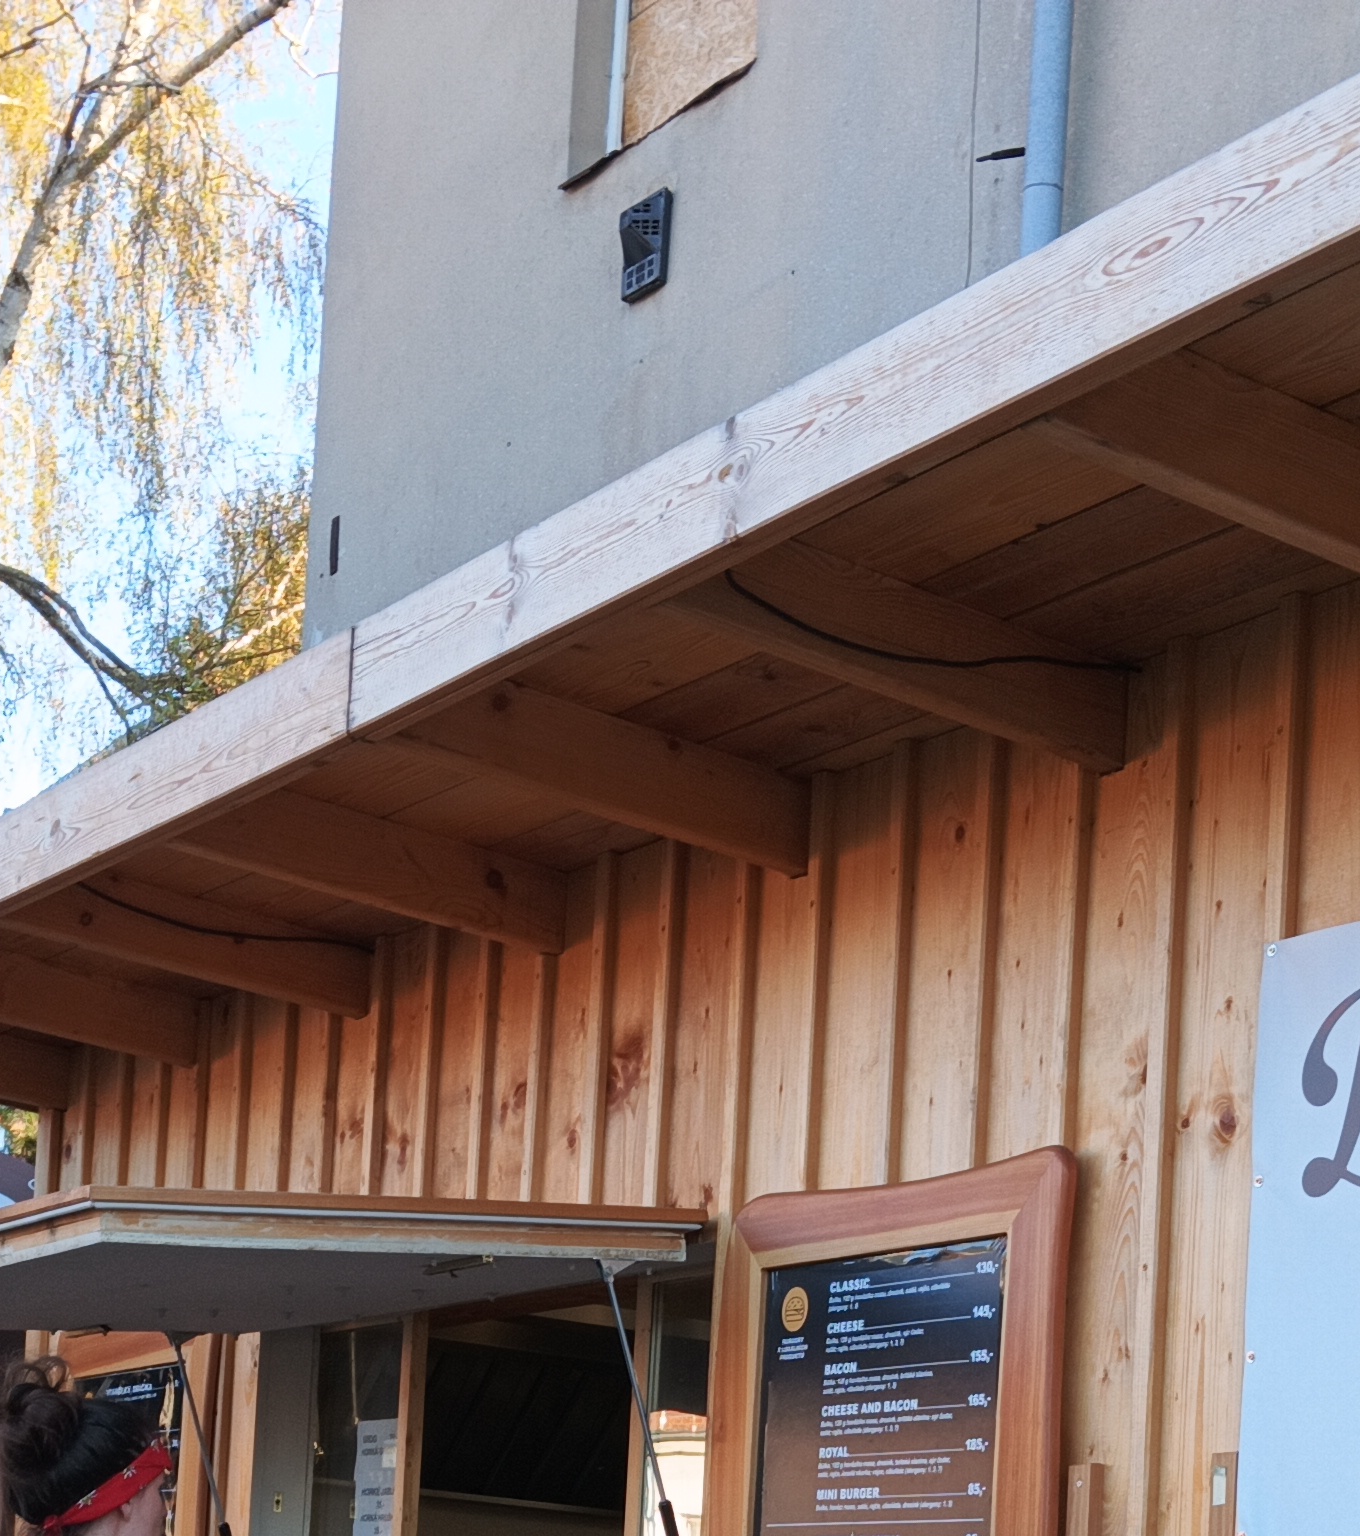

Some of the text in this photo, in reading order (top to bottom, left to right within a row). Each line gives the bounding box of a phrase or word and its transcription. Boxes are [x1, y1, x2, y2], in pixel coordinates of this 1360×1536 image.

[829, 1278, 871, 1294] CLASSIC
[826, 1319, 865, 1335] CHEESE
[824, 1362, 858, 1376] BACON
[821, 1403, 859, 1418] CHEESE
[860, 1401, 882, 1415] AND
[883, 1398, 919, 1413] BACON
[818, 1446, 850, 1459] ROYAL
[816, 1488, 838, 1501] MINI
[840, 1487, 881, 1500] BURGER
